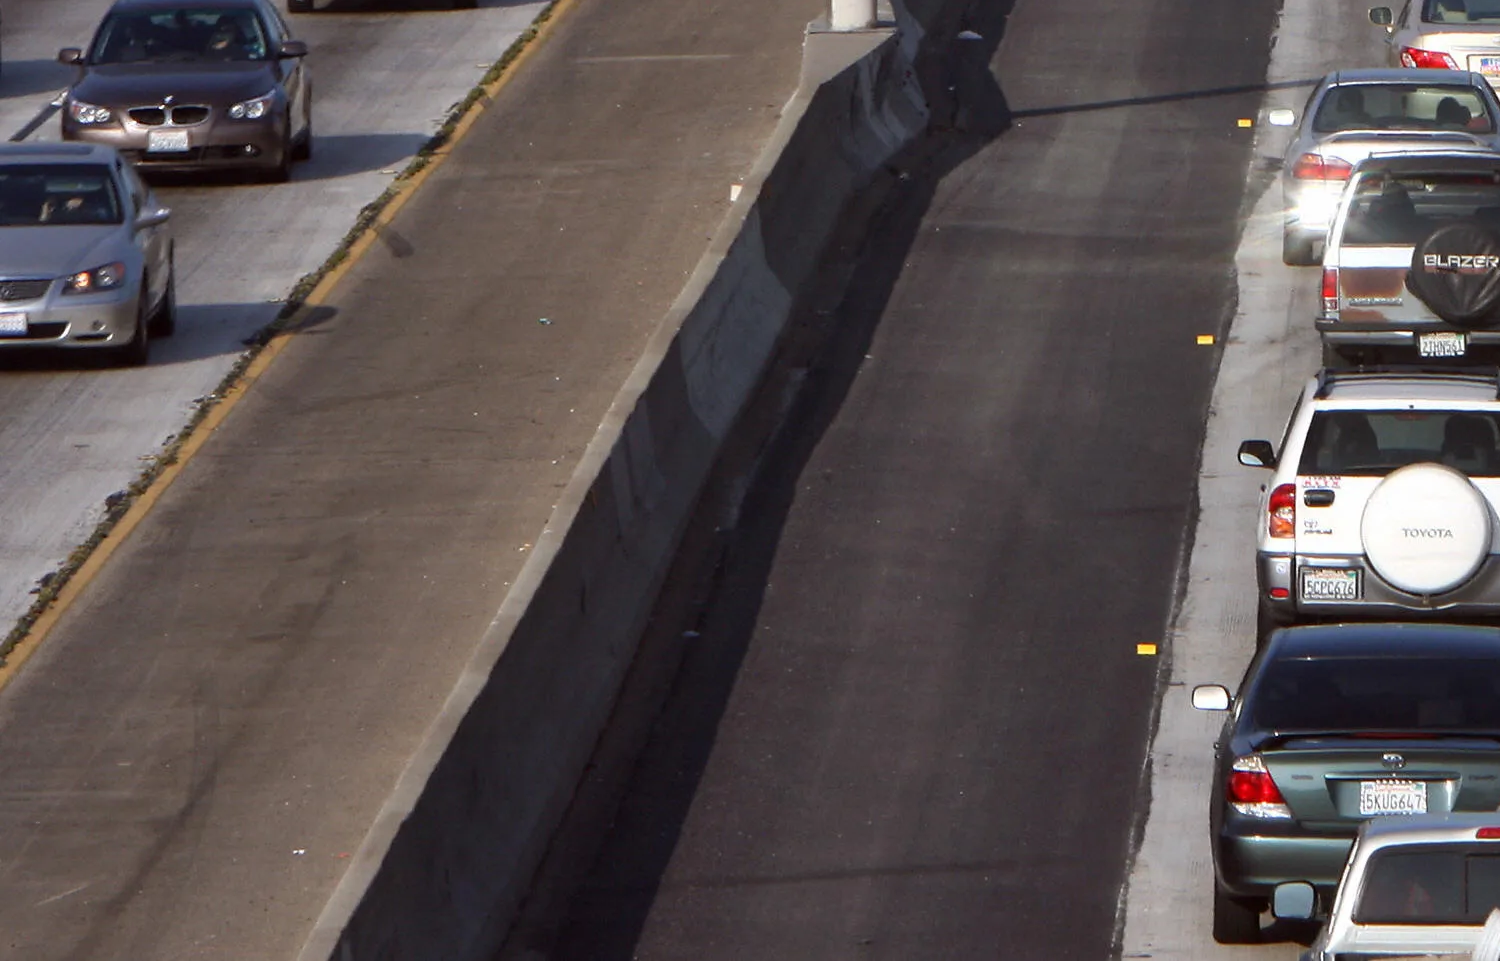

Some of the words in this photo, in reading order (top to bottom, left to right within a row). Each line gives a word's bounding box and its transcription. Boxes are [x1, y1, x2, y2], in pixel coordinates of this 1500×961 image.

[1423, 254, 1500, 268] BLAZER
[1402, 528, 1454, 539] TOYOTA
[1366, 793, 1422, 810] 5KUG647
